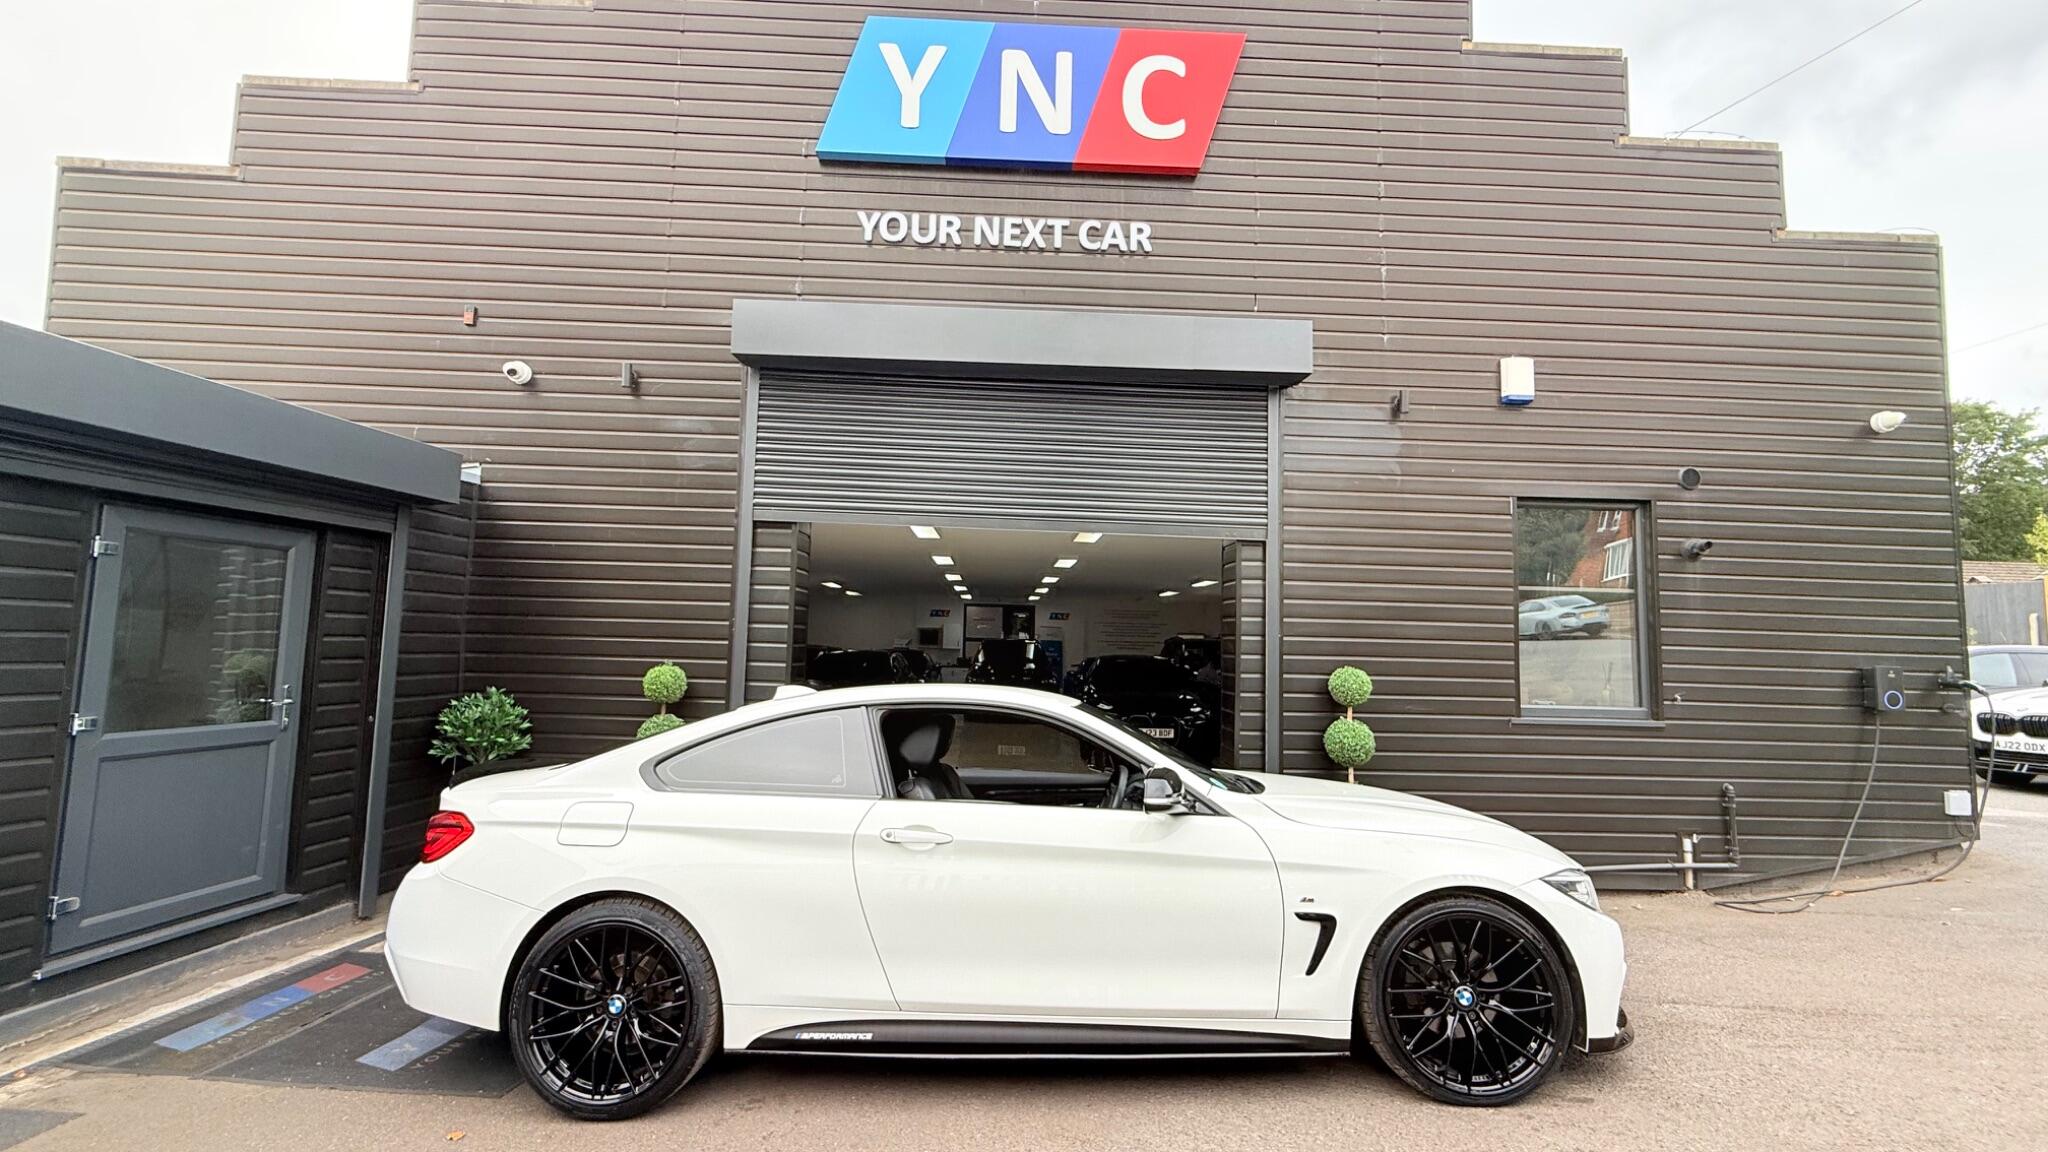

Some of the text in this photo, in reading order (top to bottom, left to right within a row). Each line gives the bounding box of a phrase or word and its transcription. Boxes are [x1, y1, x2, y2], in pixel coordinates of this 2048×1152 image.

[878, 42, 1187, 140] YNC
[857, 210, 1153, 253] YOUR NEXT CAR
